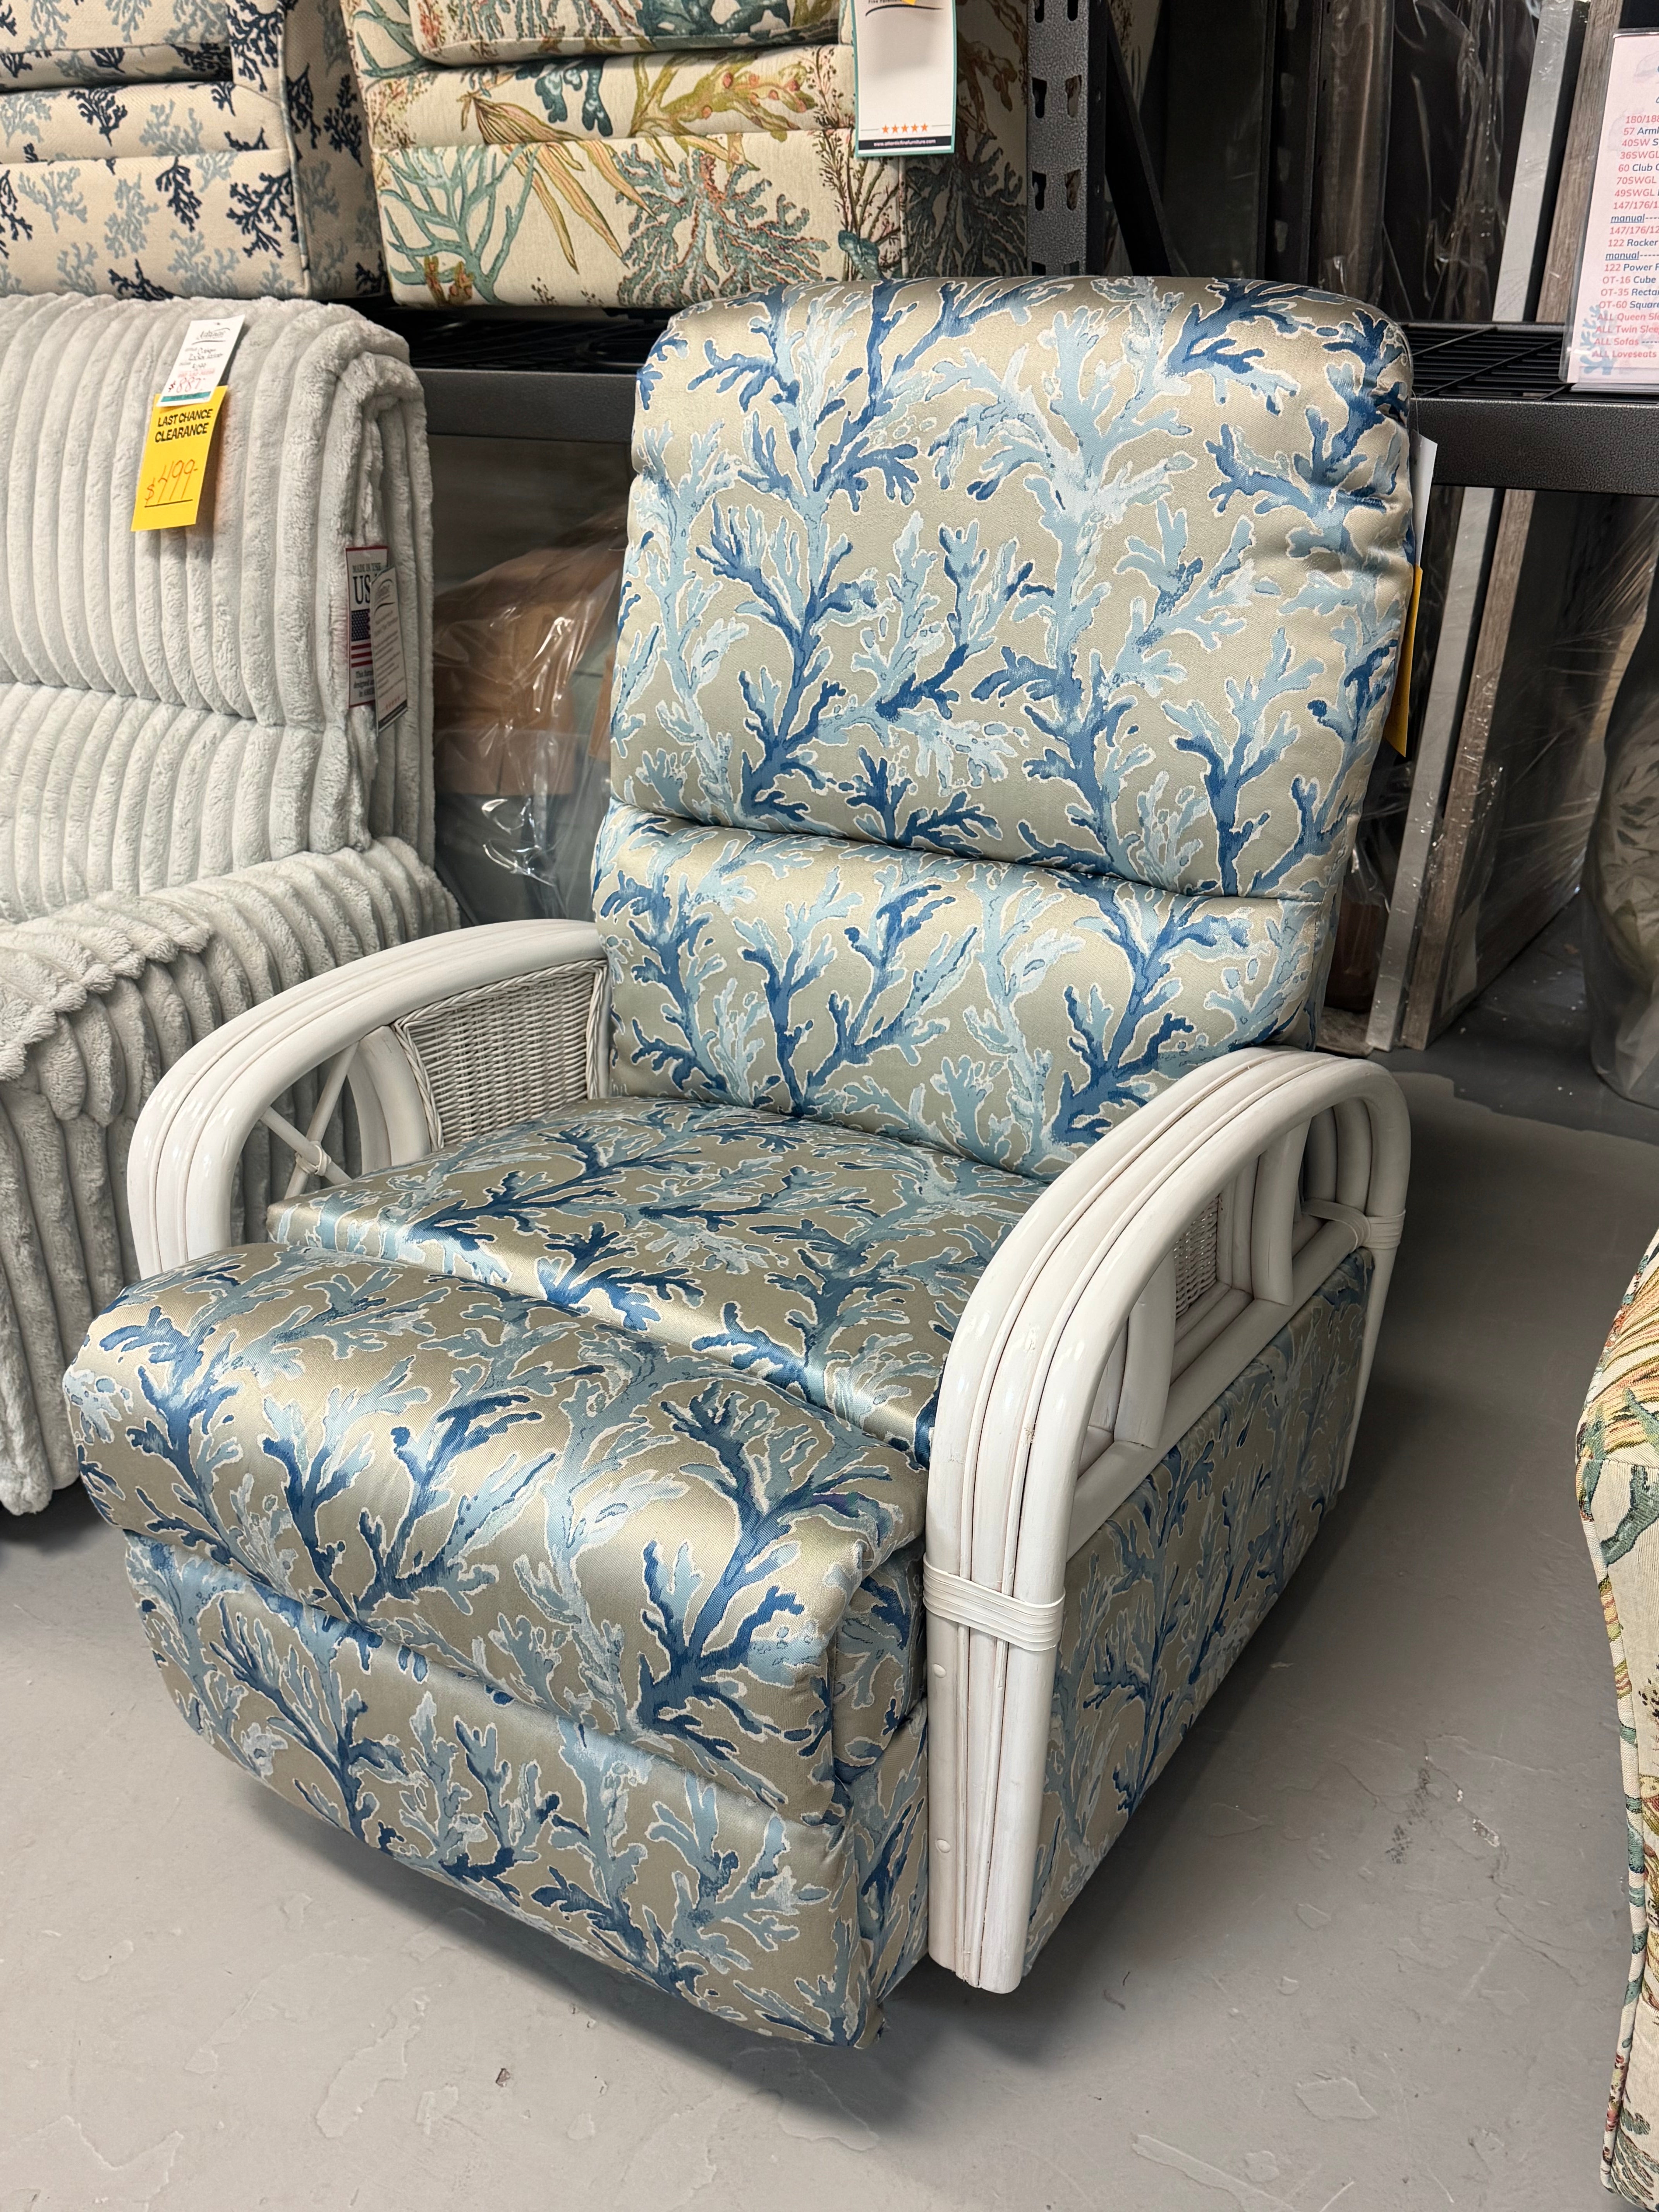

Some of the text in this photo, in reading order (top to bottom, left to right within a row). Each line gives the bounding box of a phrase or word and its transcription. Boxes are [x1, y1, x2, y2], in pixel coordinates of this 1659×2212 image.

[1623, 127, 1635, 135] 57
[1622, 139, 1650, 147] 40SW
[1618, 164, 1630, 172] 60
[1632, 163, 1653, 171] Club
[1616, 176, 1657, 185] 70SWGL
[1614, 189, 1655, 197] 49SWGL
[1613, 201, 1659, 210] 147/176/1
[1608, 239, 1625, 247] 122
[1604, 264, 1621, 272] 122
[1602, 275, 1656, 284] OT-16 Cube
[1601, 288, 1629, 297] OT-35
[1599, 301, 1628, 309] OT-60
[1597, 313, 1614, 321] ALL
[1617, 313, 1645, 322] Queen
[1615, 325, 1637, 333] Twin
[1614, 337, 1639, 345] Sofas
[1612, 350, 1657, 358] Loveseats
[158, 409, 213, 427] LAST CHANCE
[155, 422, 209, 443] CLEARANCE
[353, 574, 377, 605] US
